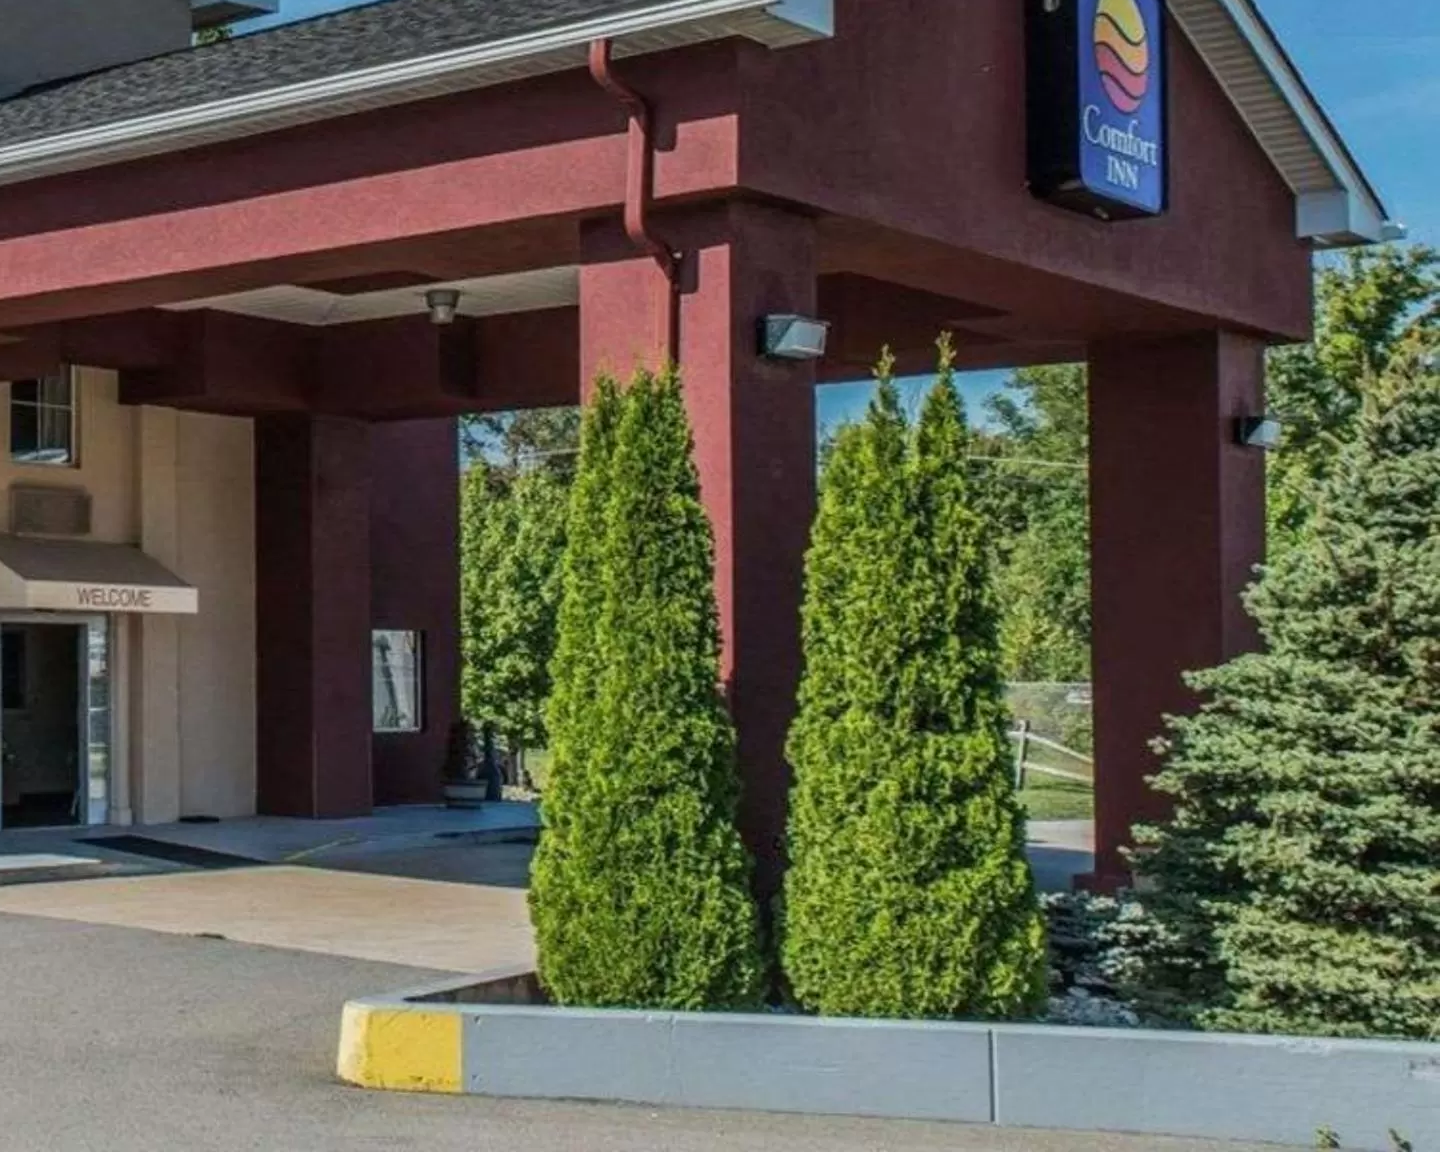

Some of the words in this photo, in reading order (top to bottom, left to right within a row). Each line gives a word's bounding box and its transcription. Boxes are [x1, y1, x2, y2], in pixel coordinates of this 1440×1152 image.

[1083, 104, 1157, 165] Comfort
[1107, 155, 1138, 190] INN
[77, 587, 153, 607] WELCOME
